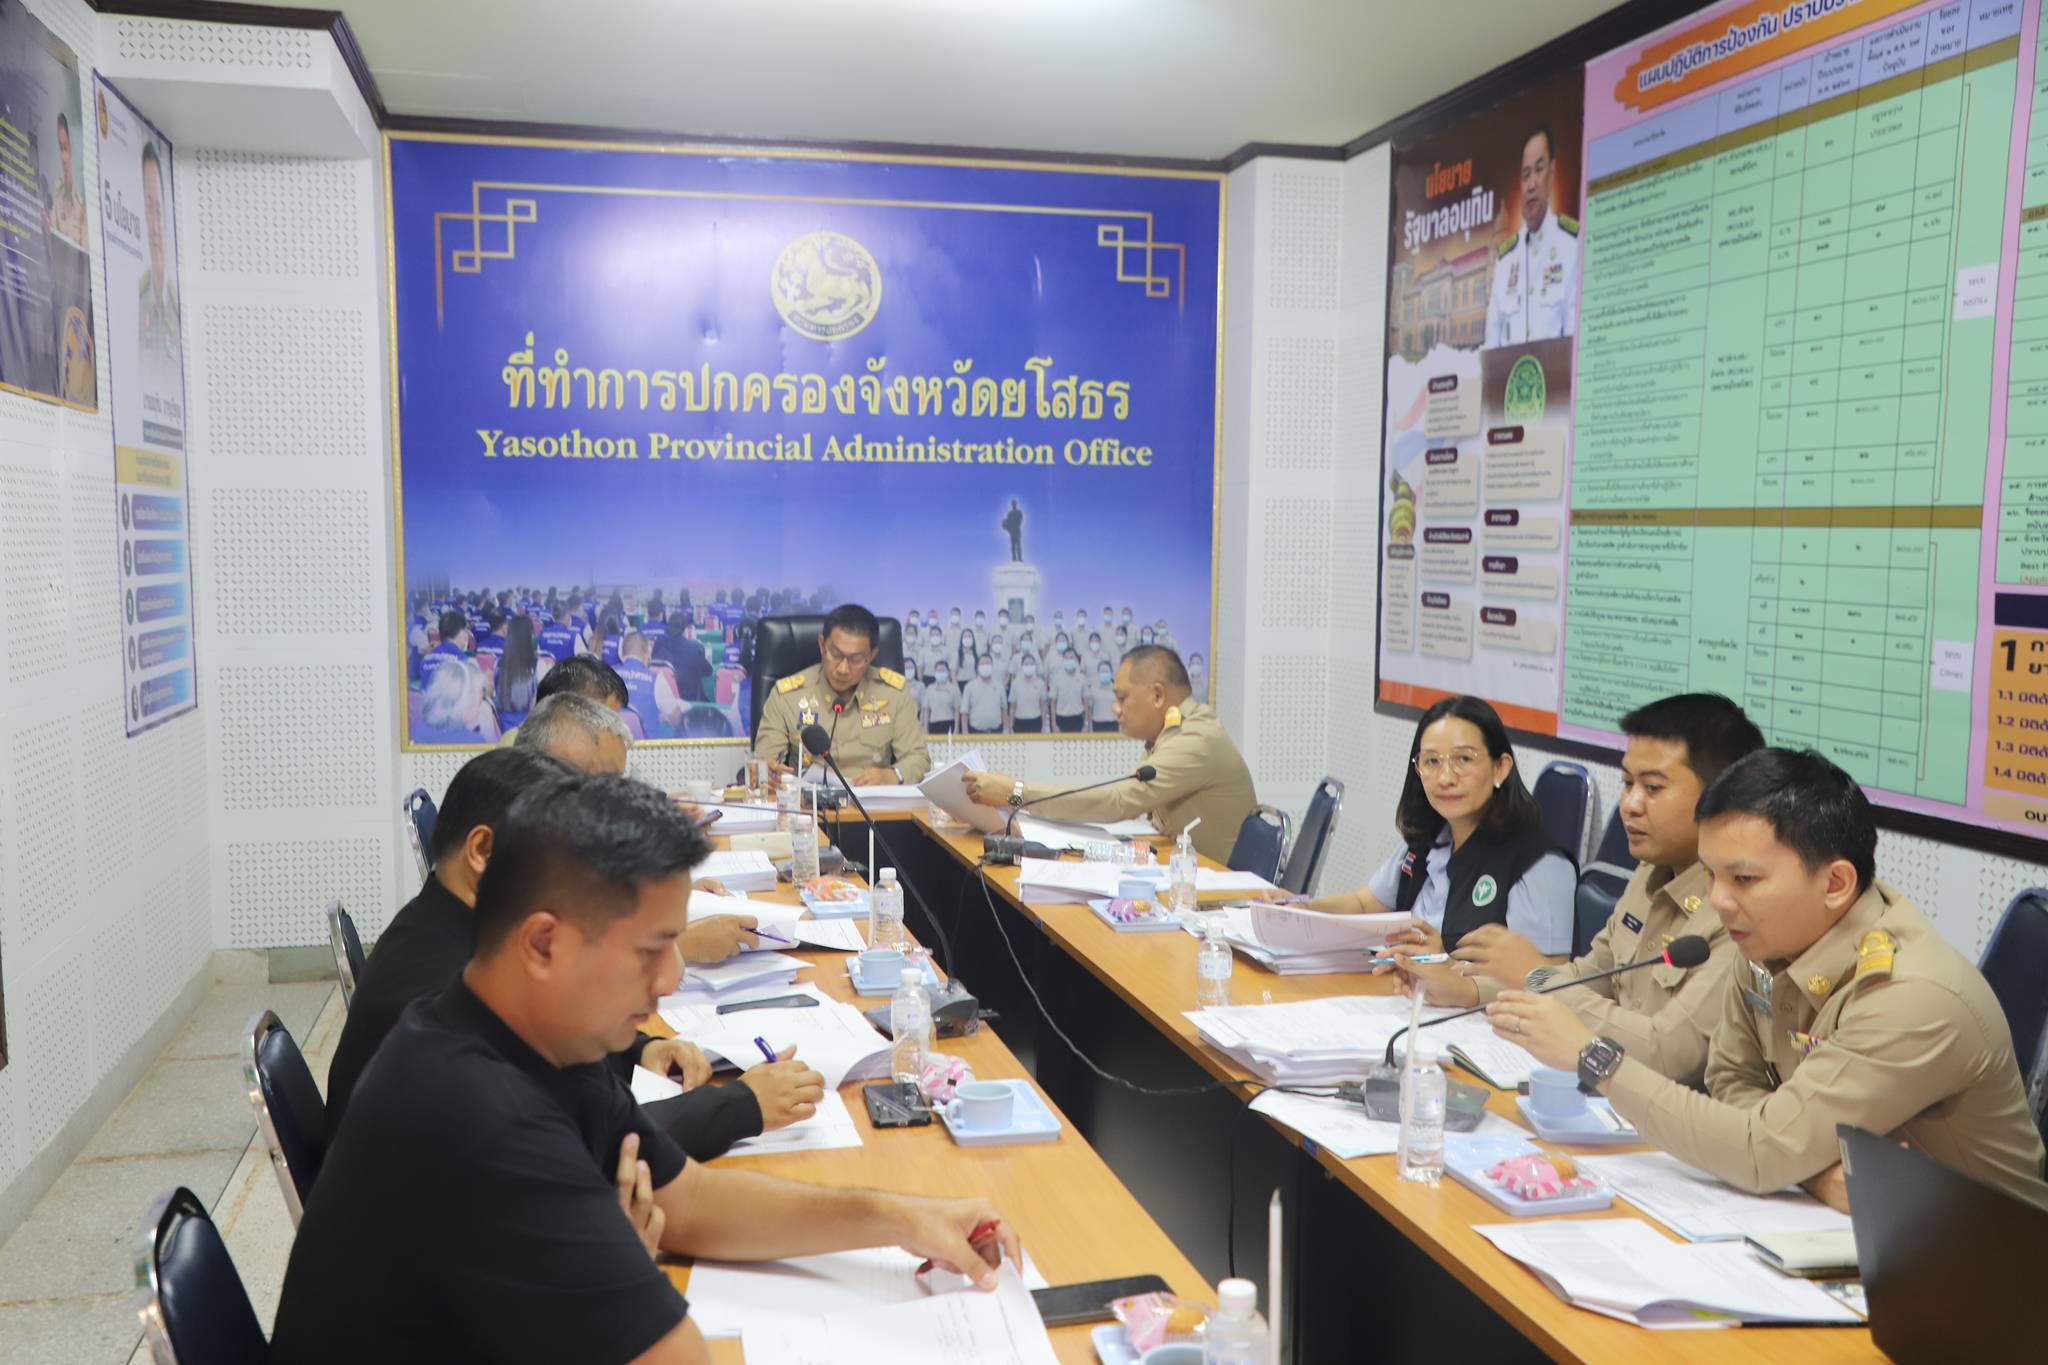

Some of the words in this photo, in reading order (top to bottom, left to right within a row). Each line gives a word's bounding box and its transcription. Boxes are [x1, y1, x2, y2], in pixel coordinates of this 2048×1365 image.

[1638, 16, 1777, 90] แผนปฏิบัติการป้องกัน
[1425, 159, 1473, 199] นโยบาย
[1404, 185, 1495, 256] รัฐบาลอนุทิน
[501, 331, 1131, 421] ที่ทำการปกครองจังหวัดยโสธร
[476, 429, 638, 459] Yasothon
[649, 432, 814, 461] Provincial
[821, 434, 1055, 465] Administration
[1064, 438, 1153, 466] Office
[2001, 640, 2016, 672] 1
[1998, 689, 2013, 701] 1.1
[1996, 715, 2015, 727] 1.2
[1995, 740, 2014, 752] 1.3
[1993, 766, 2012, 779] 1.4
[2024, 809, 2048, 824] OU
